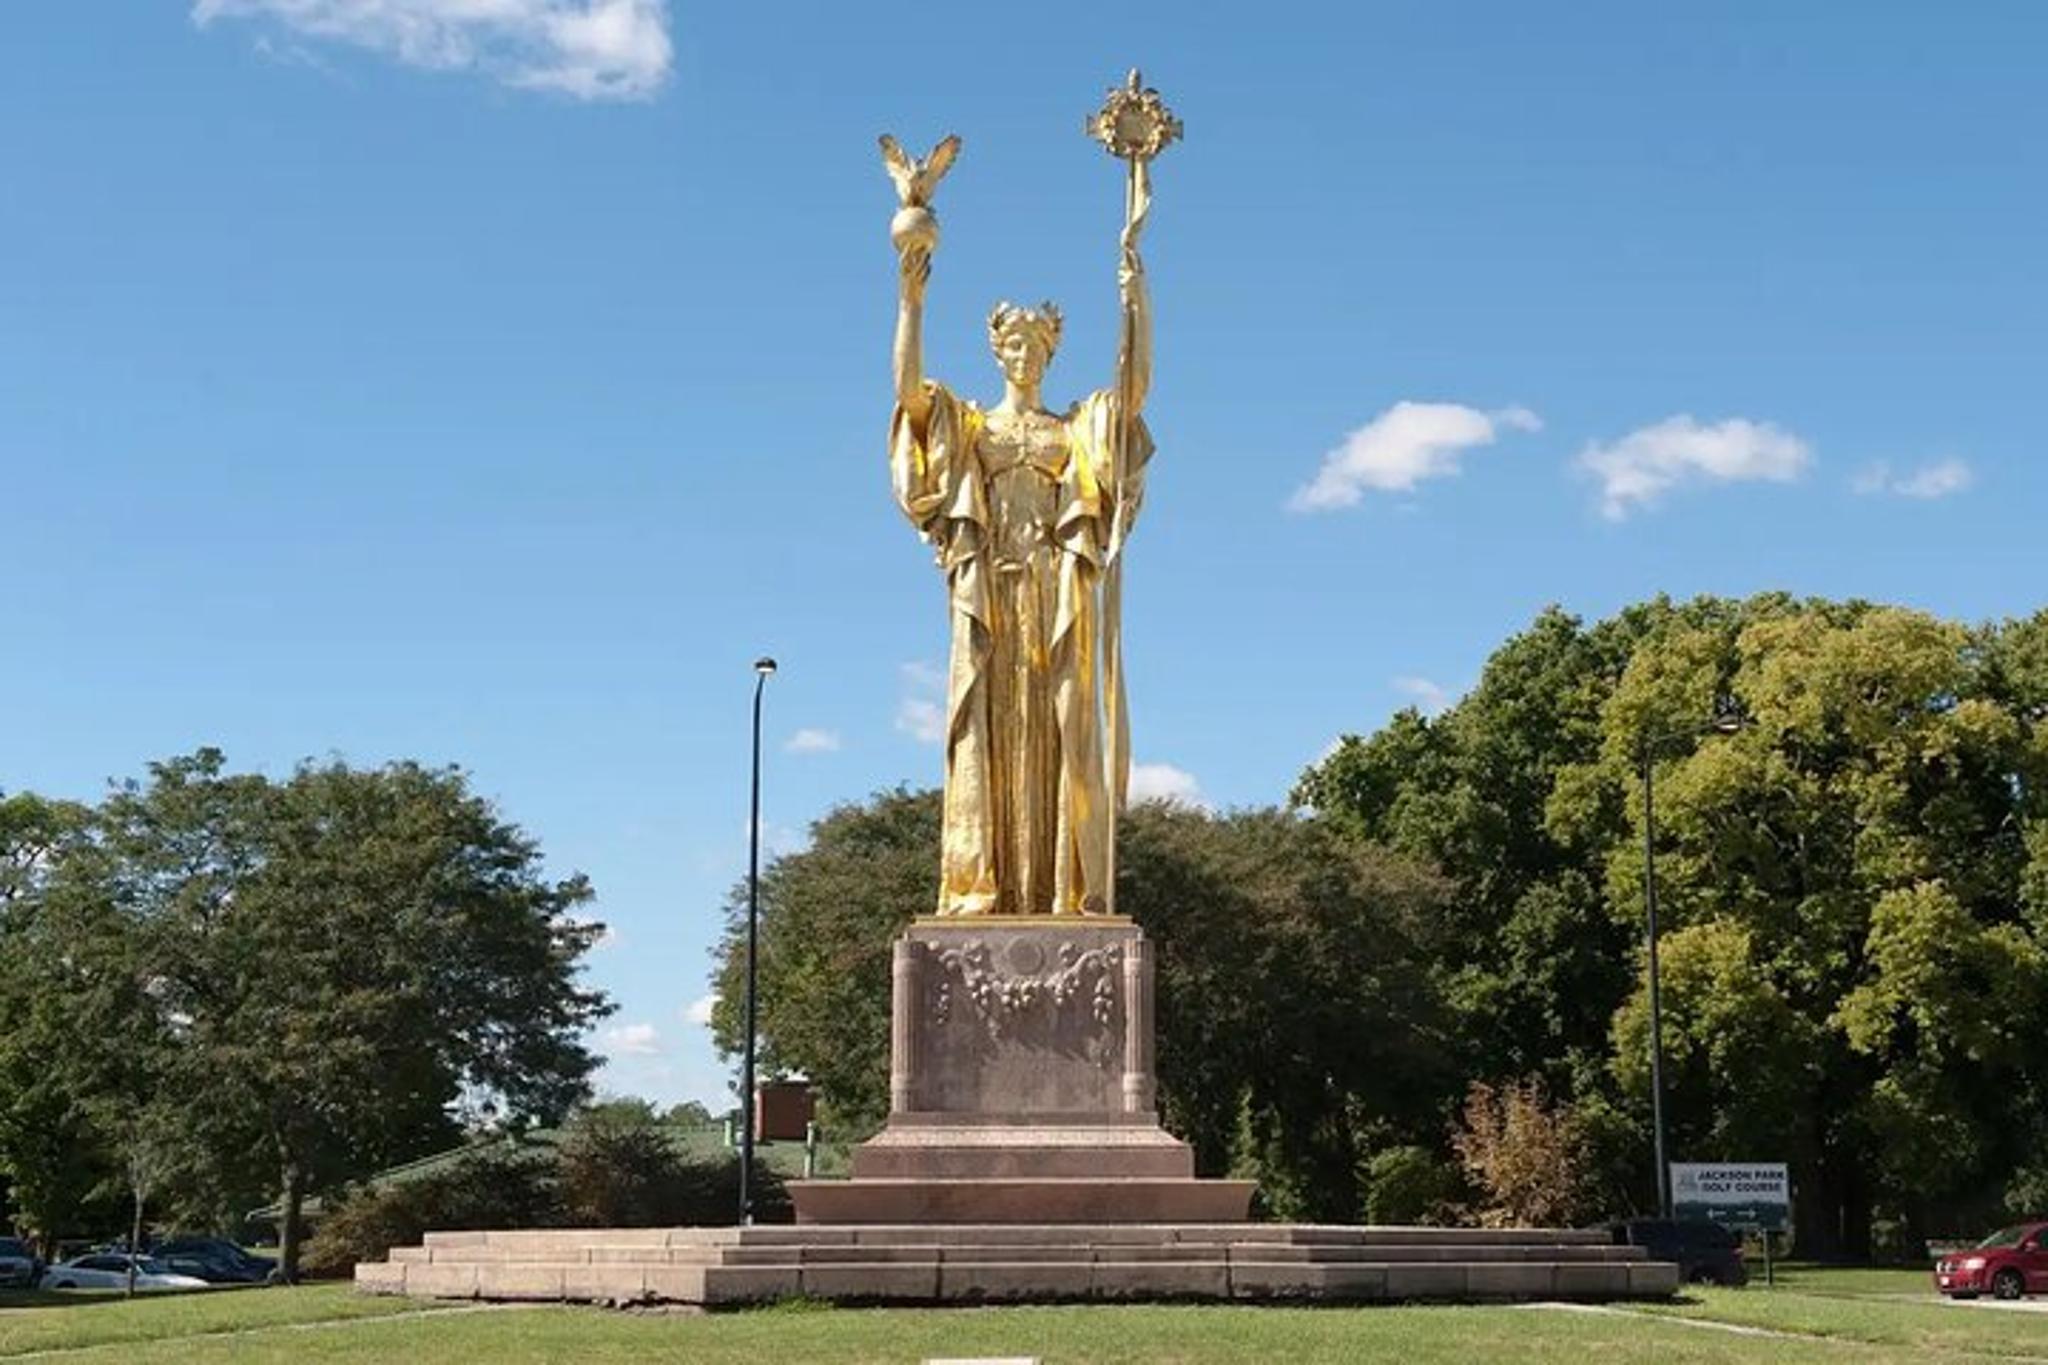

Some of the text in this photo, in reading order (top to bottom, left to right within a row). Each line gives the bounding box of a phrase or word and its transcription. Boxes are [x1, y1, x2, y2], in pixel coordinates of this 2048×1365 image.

[1698, 1171, 1784, 1180] JACKSON PARK
[1703, 1183, 1781, 1192] GOLF COURSE
